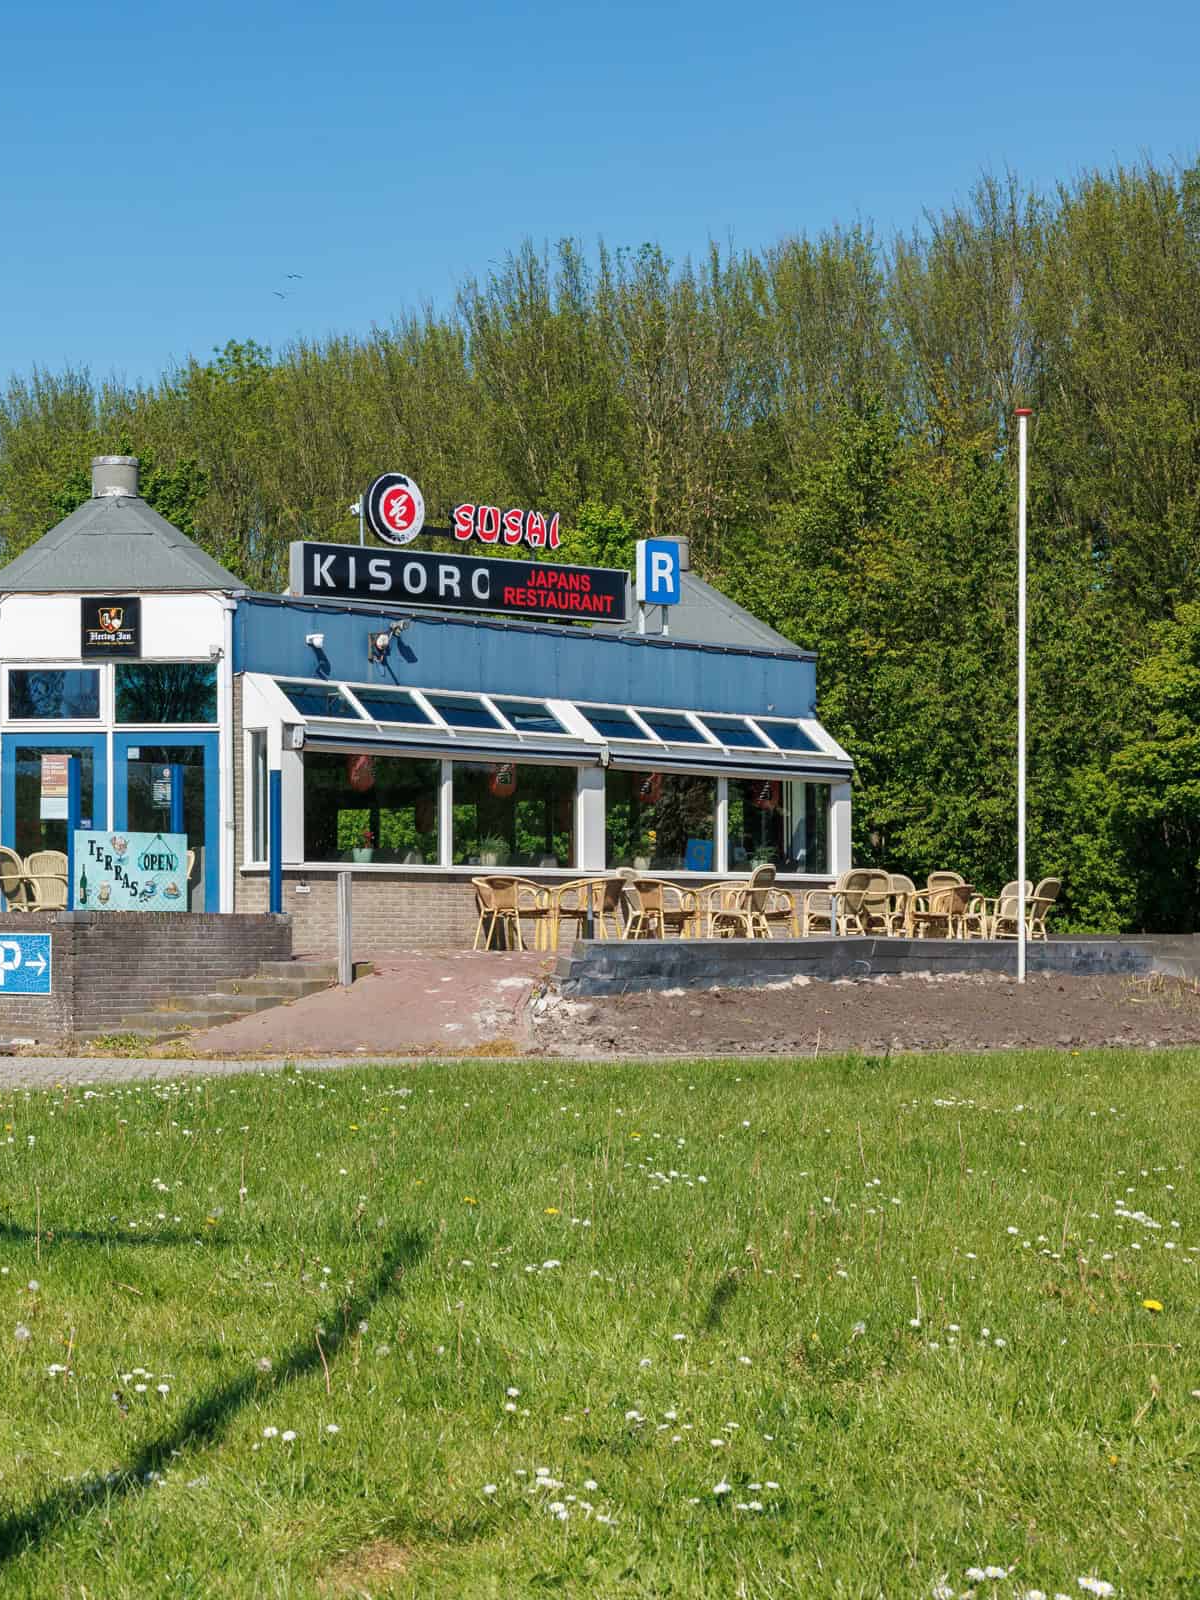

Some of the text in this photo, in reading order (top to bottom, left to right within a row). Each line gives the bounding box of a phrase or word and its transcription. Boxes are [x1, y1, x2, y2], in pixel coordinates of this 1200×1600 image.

[453, 503, 561, 549] SUSHI
[313, 553, 490, 600] KISORO
[527, 569, 591, 592] JAPANS
[652, 551, 674, 592] R
[503, 586, 615, 613] RESTAURANT
[88, 840, 138, 896] TERRAS
[143, 854, 174, 871] OPEN
